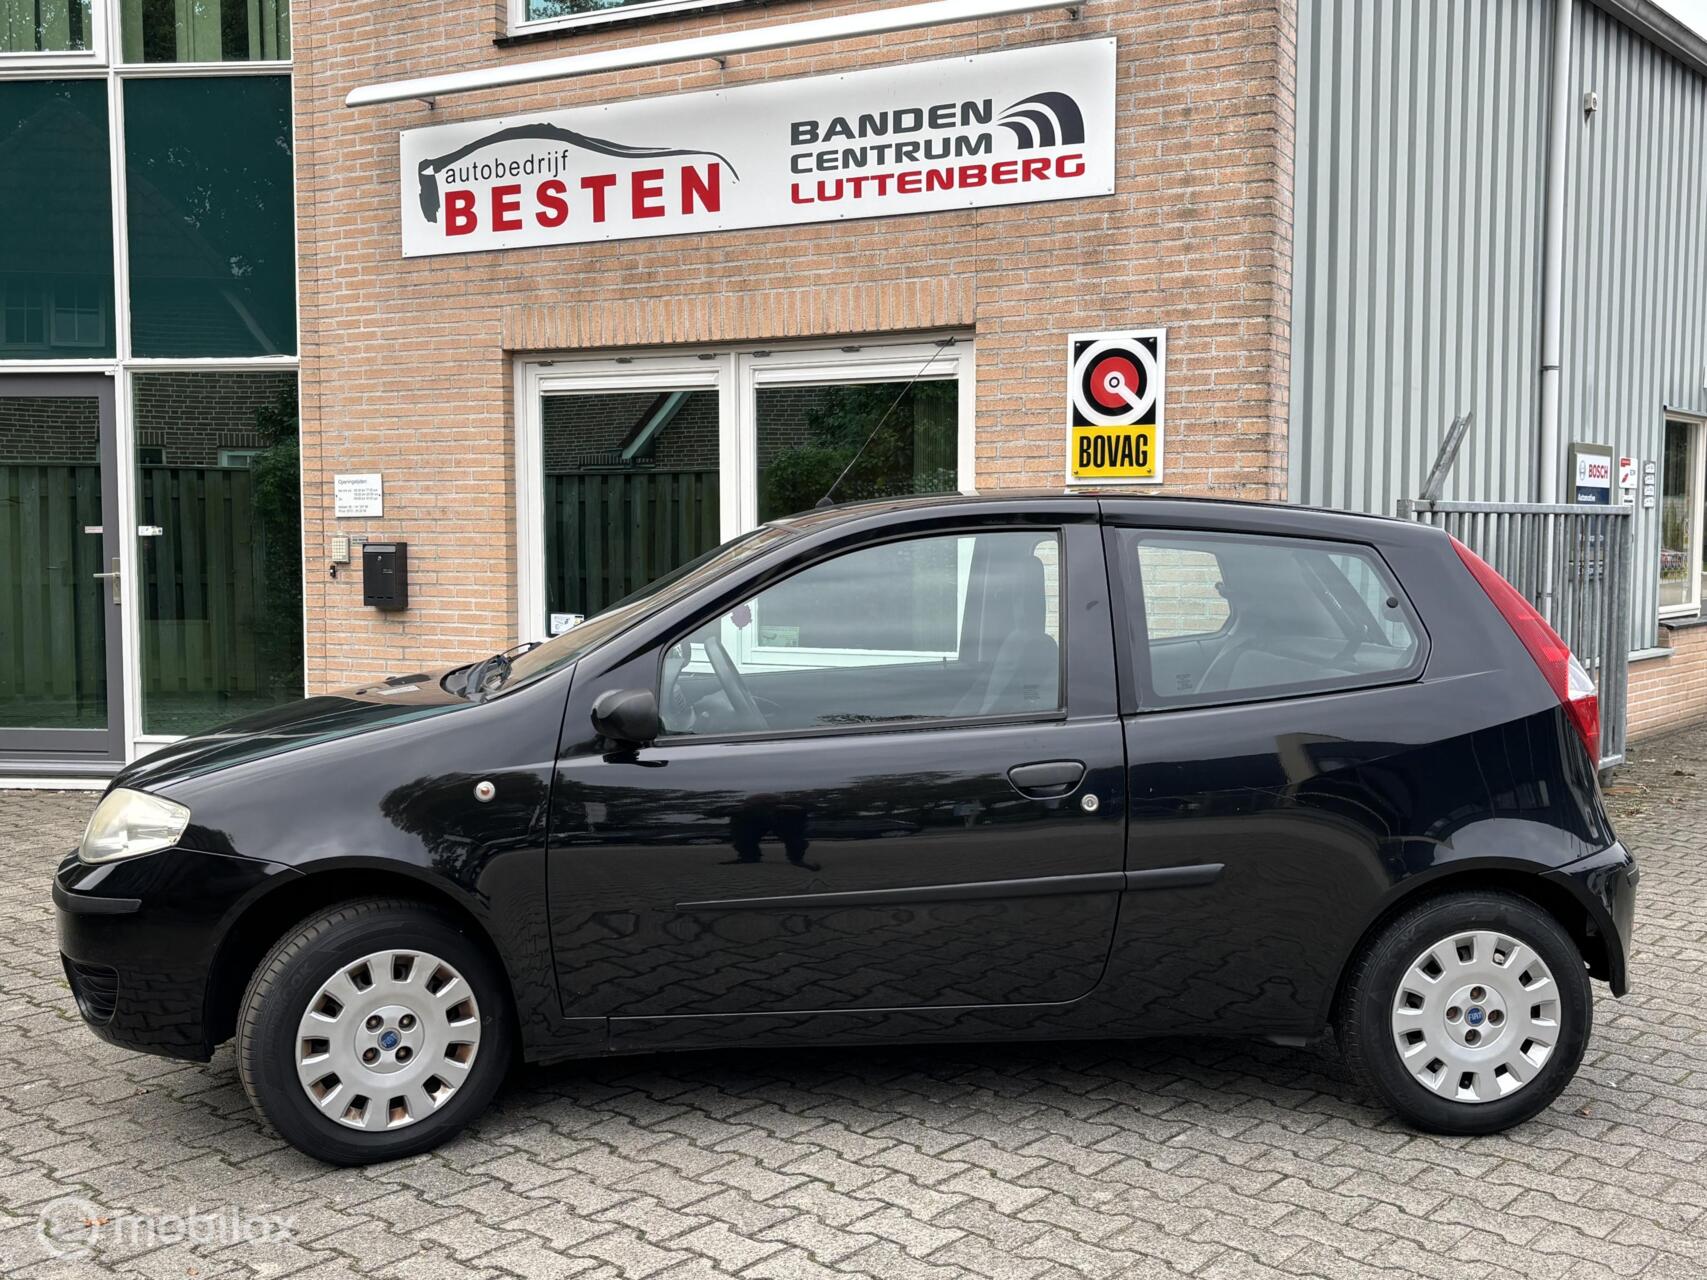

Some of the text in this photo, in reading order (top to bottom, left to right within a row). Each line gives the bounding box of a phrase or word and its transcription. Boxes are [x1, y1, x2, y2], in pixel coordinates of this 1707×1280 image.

[790, 98, 993, 146] BANDEN
[445, 149, 569, 184] autobedrijf
[790, 132, 993, 174] CENTRUM
[791, 153, 1086, 205] LUTTENBERG
[444, 162, 721, 237] BESTEN
[1078, 433, 1149, 469] BOVAG
[1588, 463, 1608, 479] BOSCH
[1468, 1011, 1482, 1021] FIAT
